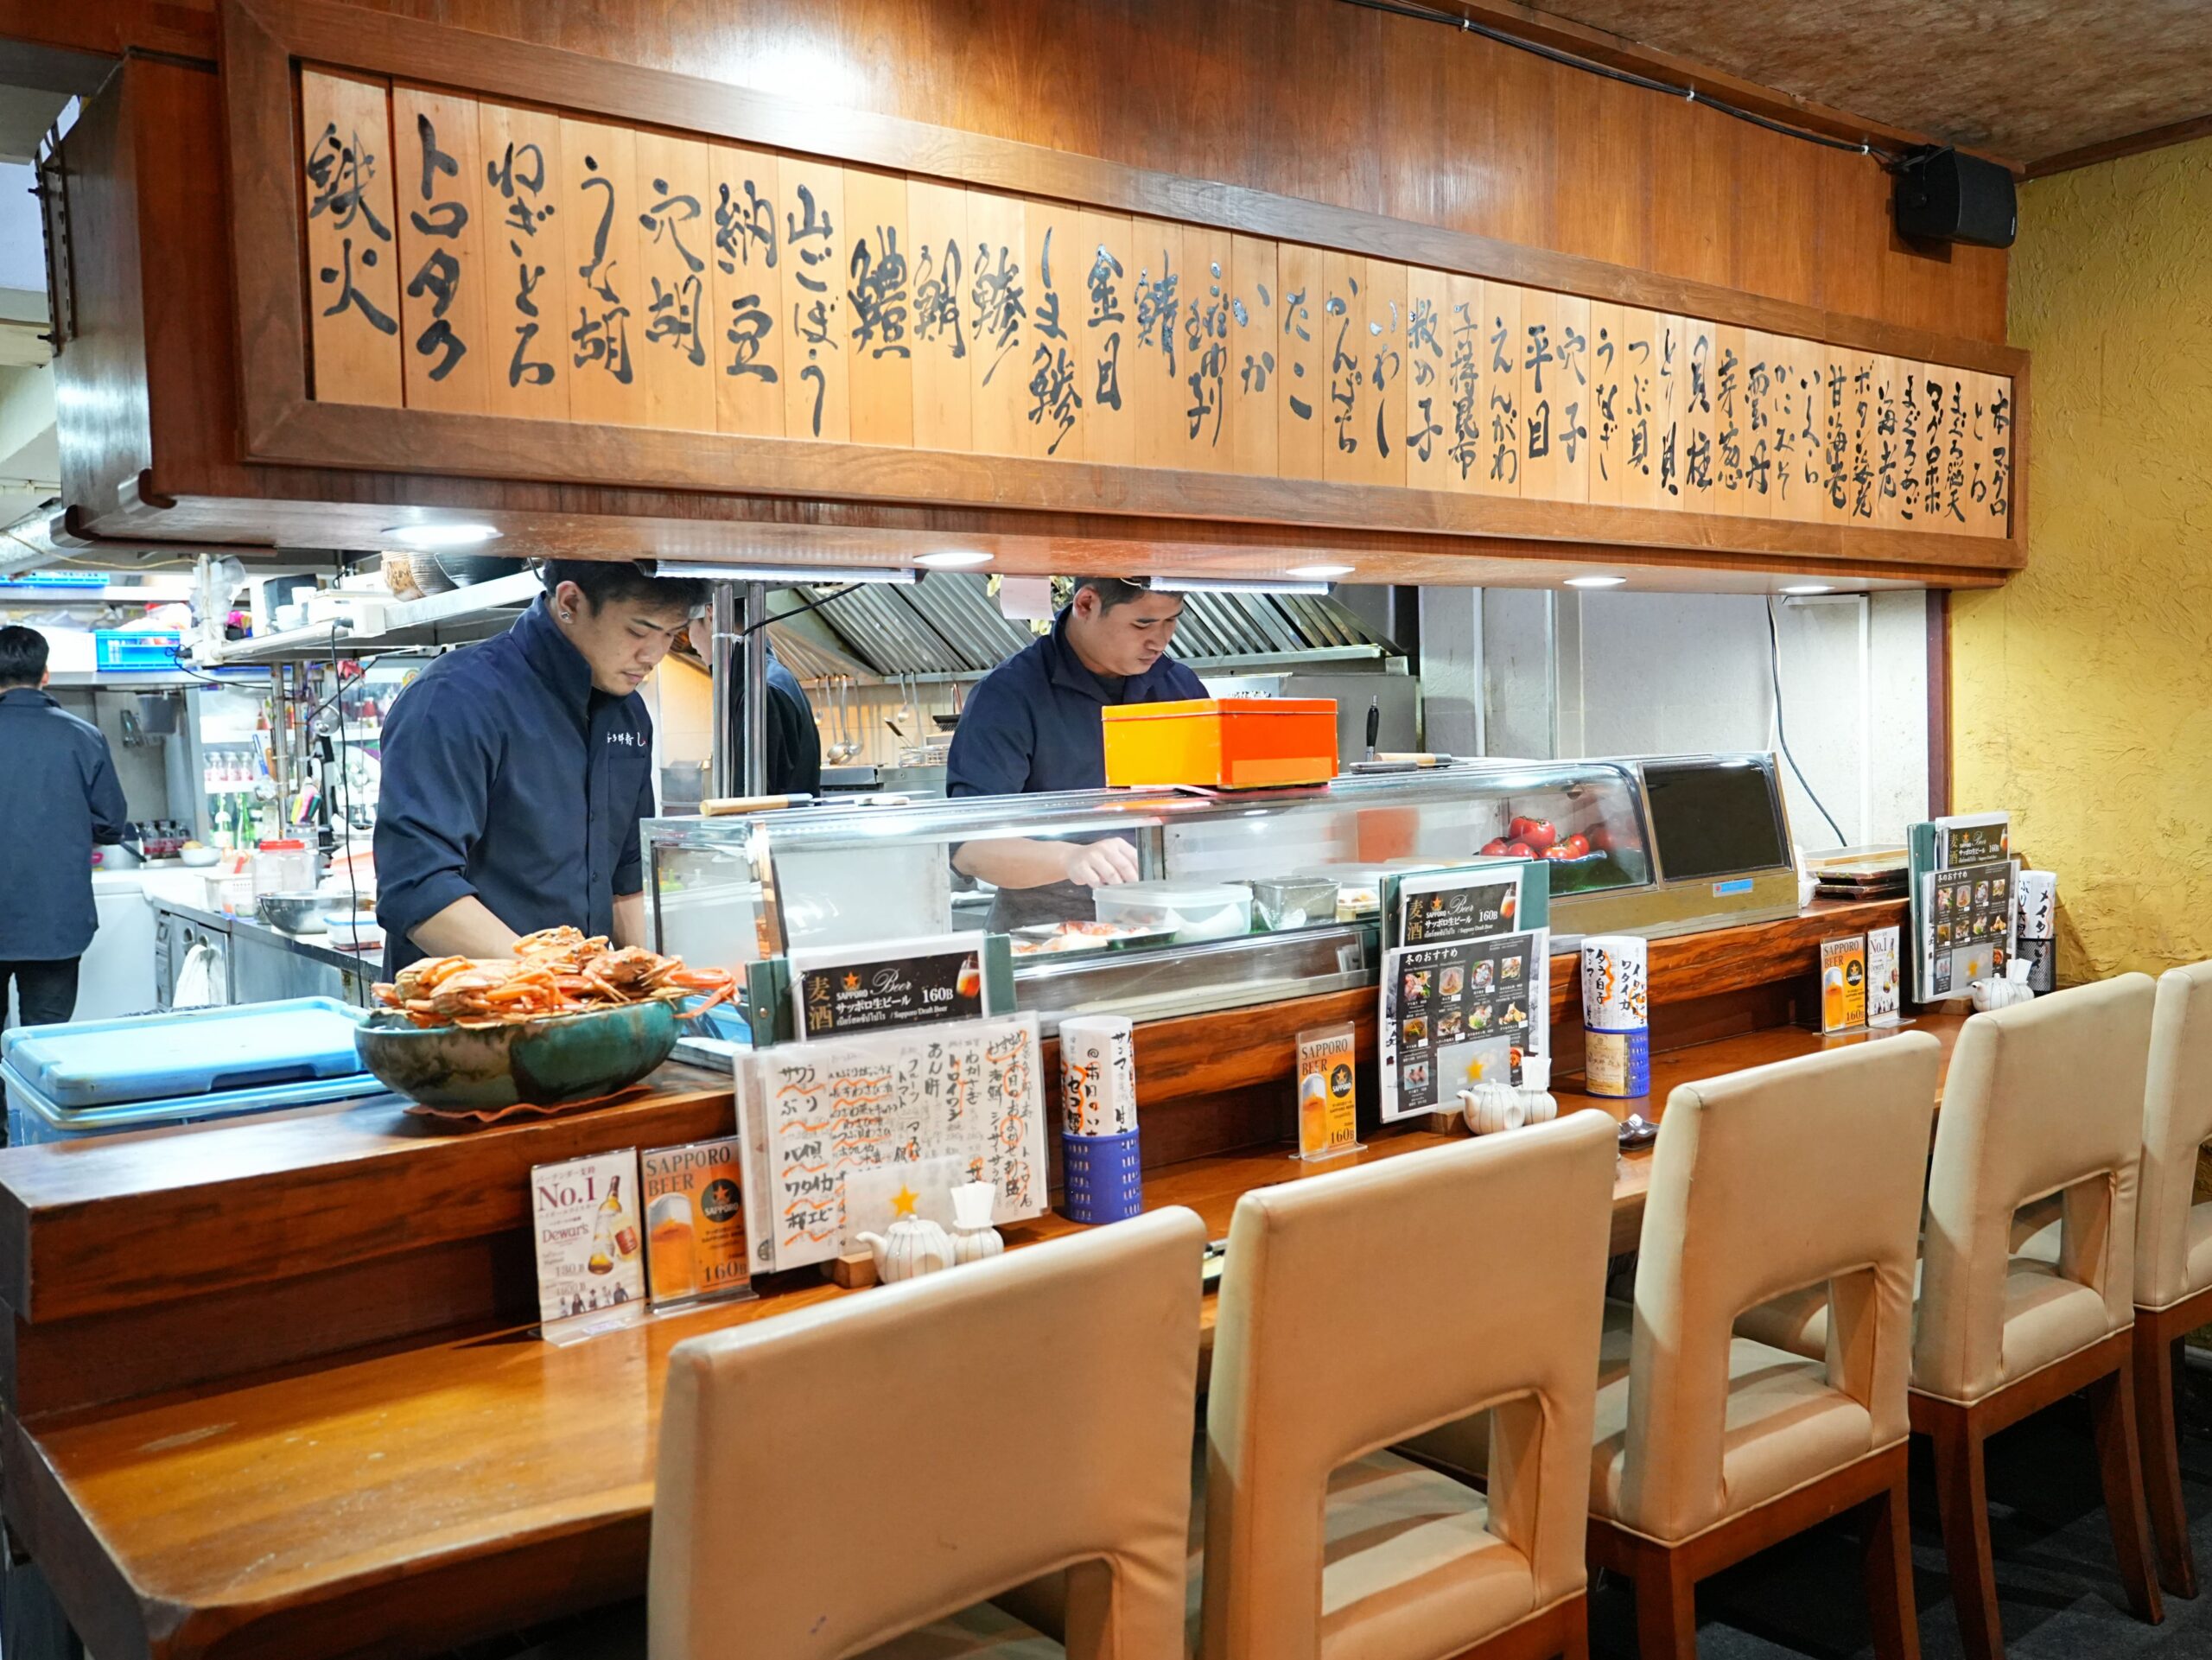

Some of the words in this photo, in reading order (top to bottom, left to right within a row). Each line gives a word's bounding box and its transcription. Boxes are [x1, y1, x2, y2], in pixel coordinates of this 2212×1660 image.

[308, 122, 397, 335] 鉄火
[407, 113, 468, 381] トロタク
[715, 180, 778, 384] 納豆
[788, 184, 838, 437] 山ごぼう
[1087, 243, 1126, 411] 金目
[1233, 283, 1274, 395] いか
[1284, 286, 1313, 420] たこ
[1326, 277, 1363, 454] かんぱち
[1369, 299, 1400, 459] いわし
[1524, 324, 1553, 459] 平目
[1490, 315, 1518, 484] えんがわ
[1555, 327, 1587, 463] 穴子
[1626, 340, 1651, 475] つぶ貝
[1449, 894, 1474, 915] Beer
[1478, 910, 1498, 922] 160B
[1407, 900, 1423, 941] 麦酒
[1425, 915, 1472, 929] サッポロ生ビール
[1405, 948, 1459, 965] 冬のおすすめ
[1823, 940, 1859, 957] SAPPORO
[1870, 938, 1887, 954] No.1
[1824, 956, 1843, 968] BEER
[836, 989, 868, 1001] SAPPORO
[872, 967, 912, 995] Beer
[922, 989, 954, 1003] 160B
[1619, 960, 1631, 1010] ワタイカ
[807, 976, 833, 1031] 麦酒
[836, 995, 912, 1014] サッポロ生ビール
[1301, 1038, 1348, 1060] SAPPORO
[779, 1065, 815, 1084] サワラ
[925, 1043, 943, 1098] あん肝
[1301, 1059, 1327, 1076] BEER
[1332, 1083, 1351, 1092] SAPPORO
[781, 1097, 817, 1115] ぶり
[1331, 1128, 1354, 1144] 160B
[646, 1146, 730, 1176] SAPPORO
[538, 1177, 597, 1212] No.1
[648, 1173, 694, 1196] BEER
[704, 1202, 739, 1216] SAPPORO
[542, 1224, 589, 1243] Dewar's
[705, 1262, 747, 1282] 160B
